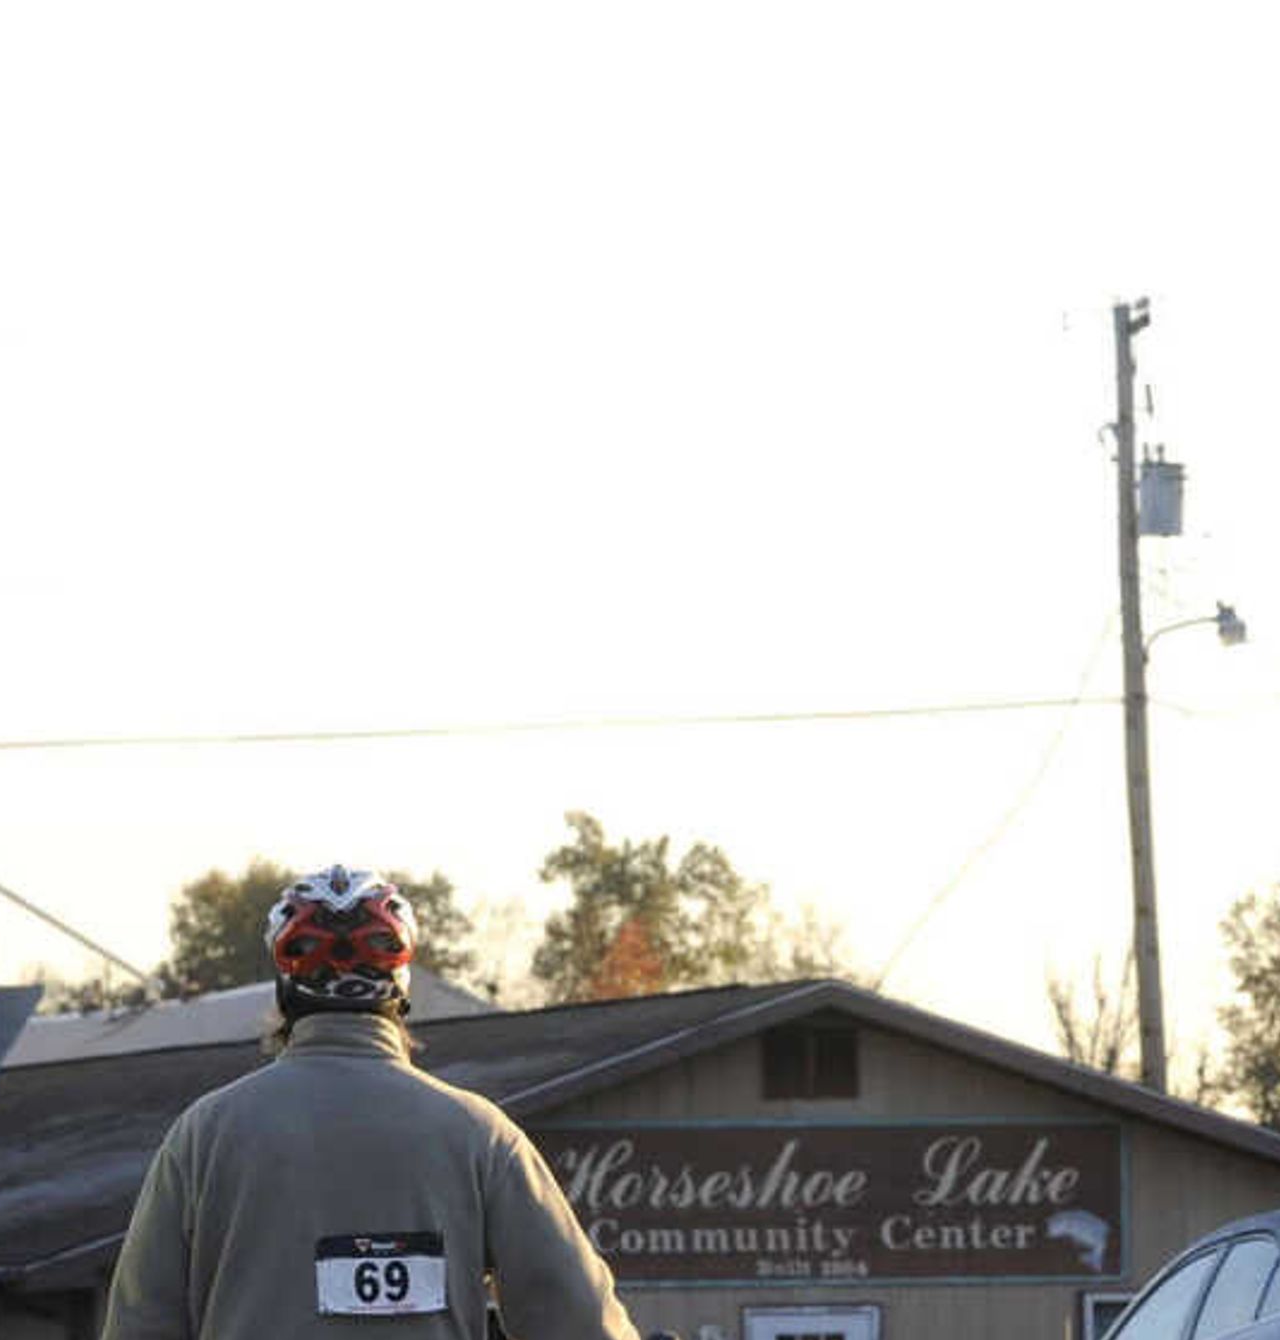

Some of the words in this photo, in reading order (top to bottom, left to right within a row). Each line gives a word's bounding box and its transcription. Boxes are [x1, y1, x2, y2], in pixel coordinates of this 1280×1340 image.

[558, 1138, 867, 1209] Horseshoe
[913, 1136, 1080, 1206] Lake
[589, 1216, 856, 1258] Community
[880, 1214, 1036, 1250] Center
[354, 1260, 410, 1304] 69
